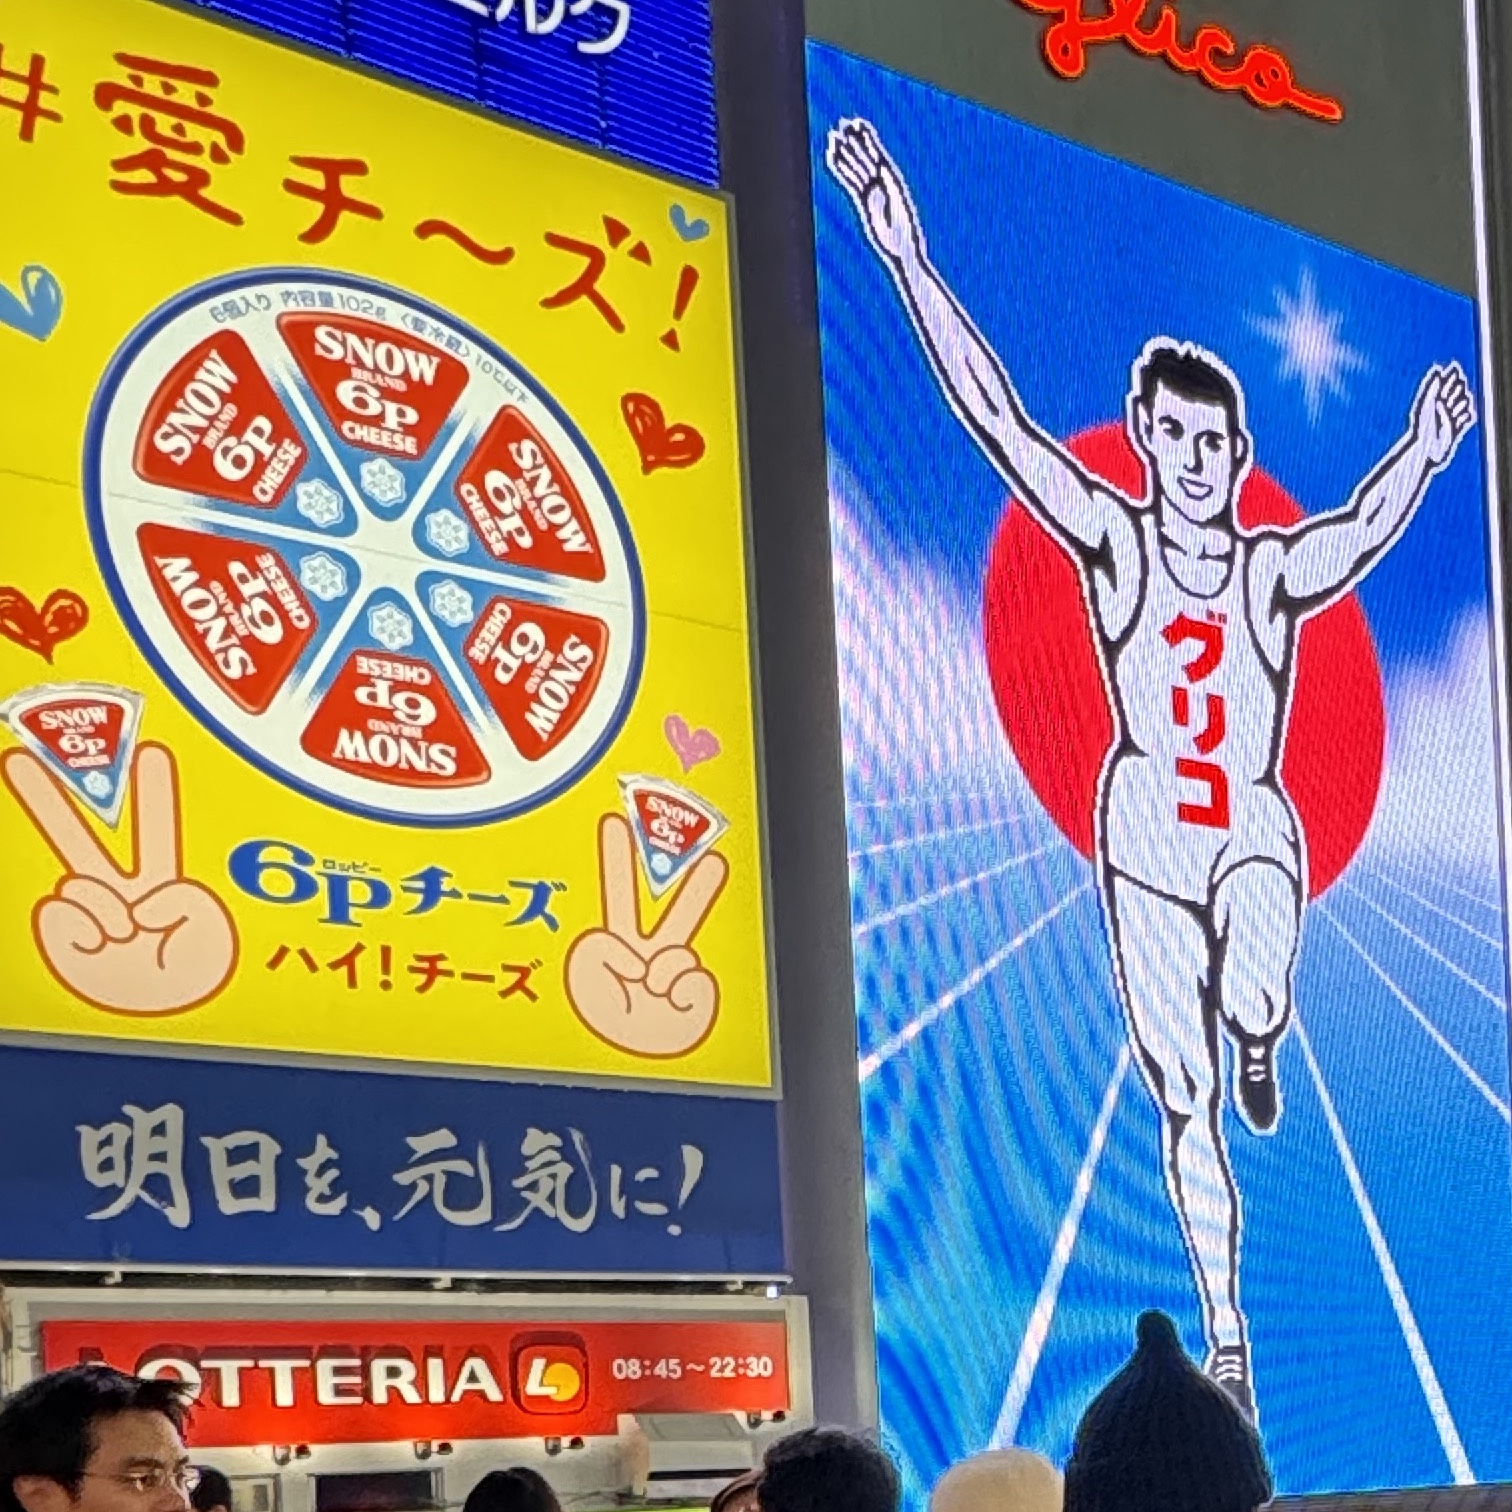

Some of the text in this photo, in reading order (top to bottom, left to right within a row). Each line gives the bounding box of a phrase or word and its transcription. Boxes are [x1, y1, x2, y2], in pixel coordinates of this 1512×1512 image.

[314, 324, 441, 386] SNOW
[152, 348, 239, 466] SNOW
[340, 420, 418, 456] CHEESE
[252, 437, 302, 503] CHEESE
[507, 438, 594, 554] SNOW
[152, 554, 258, 680] SNOW
[355, 654, 432, 686] CHEESE
[523, 633, 594, 743] SNOW
[38, 704, 108, 730] SNOW
[1160, 608, 1230, 830] グリコ
[331, 726, 458, 777] SNOW
[644, 796, 700, 828] SNOW
[75, 1102, 705, 1237] 明日を、元気に!
[134, 1356, 504, 1408] OTTERIA
